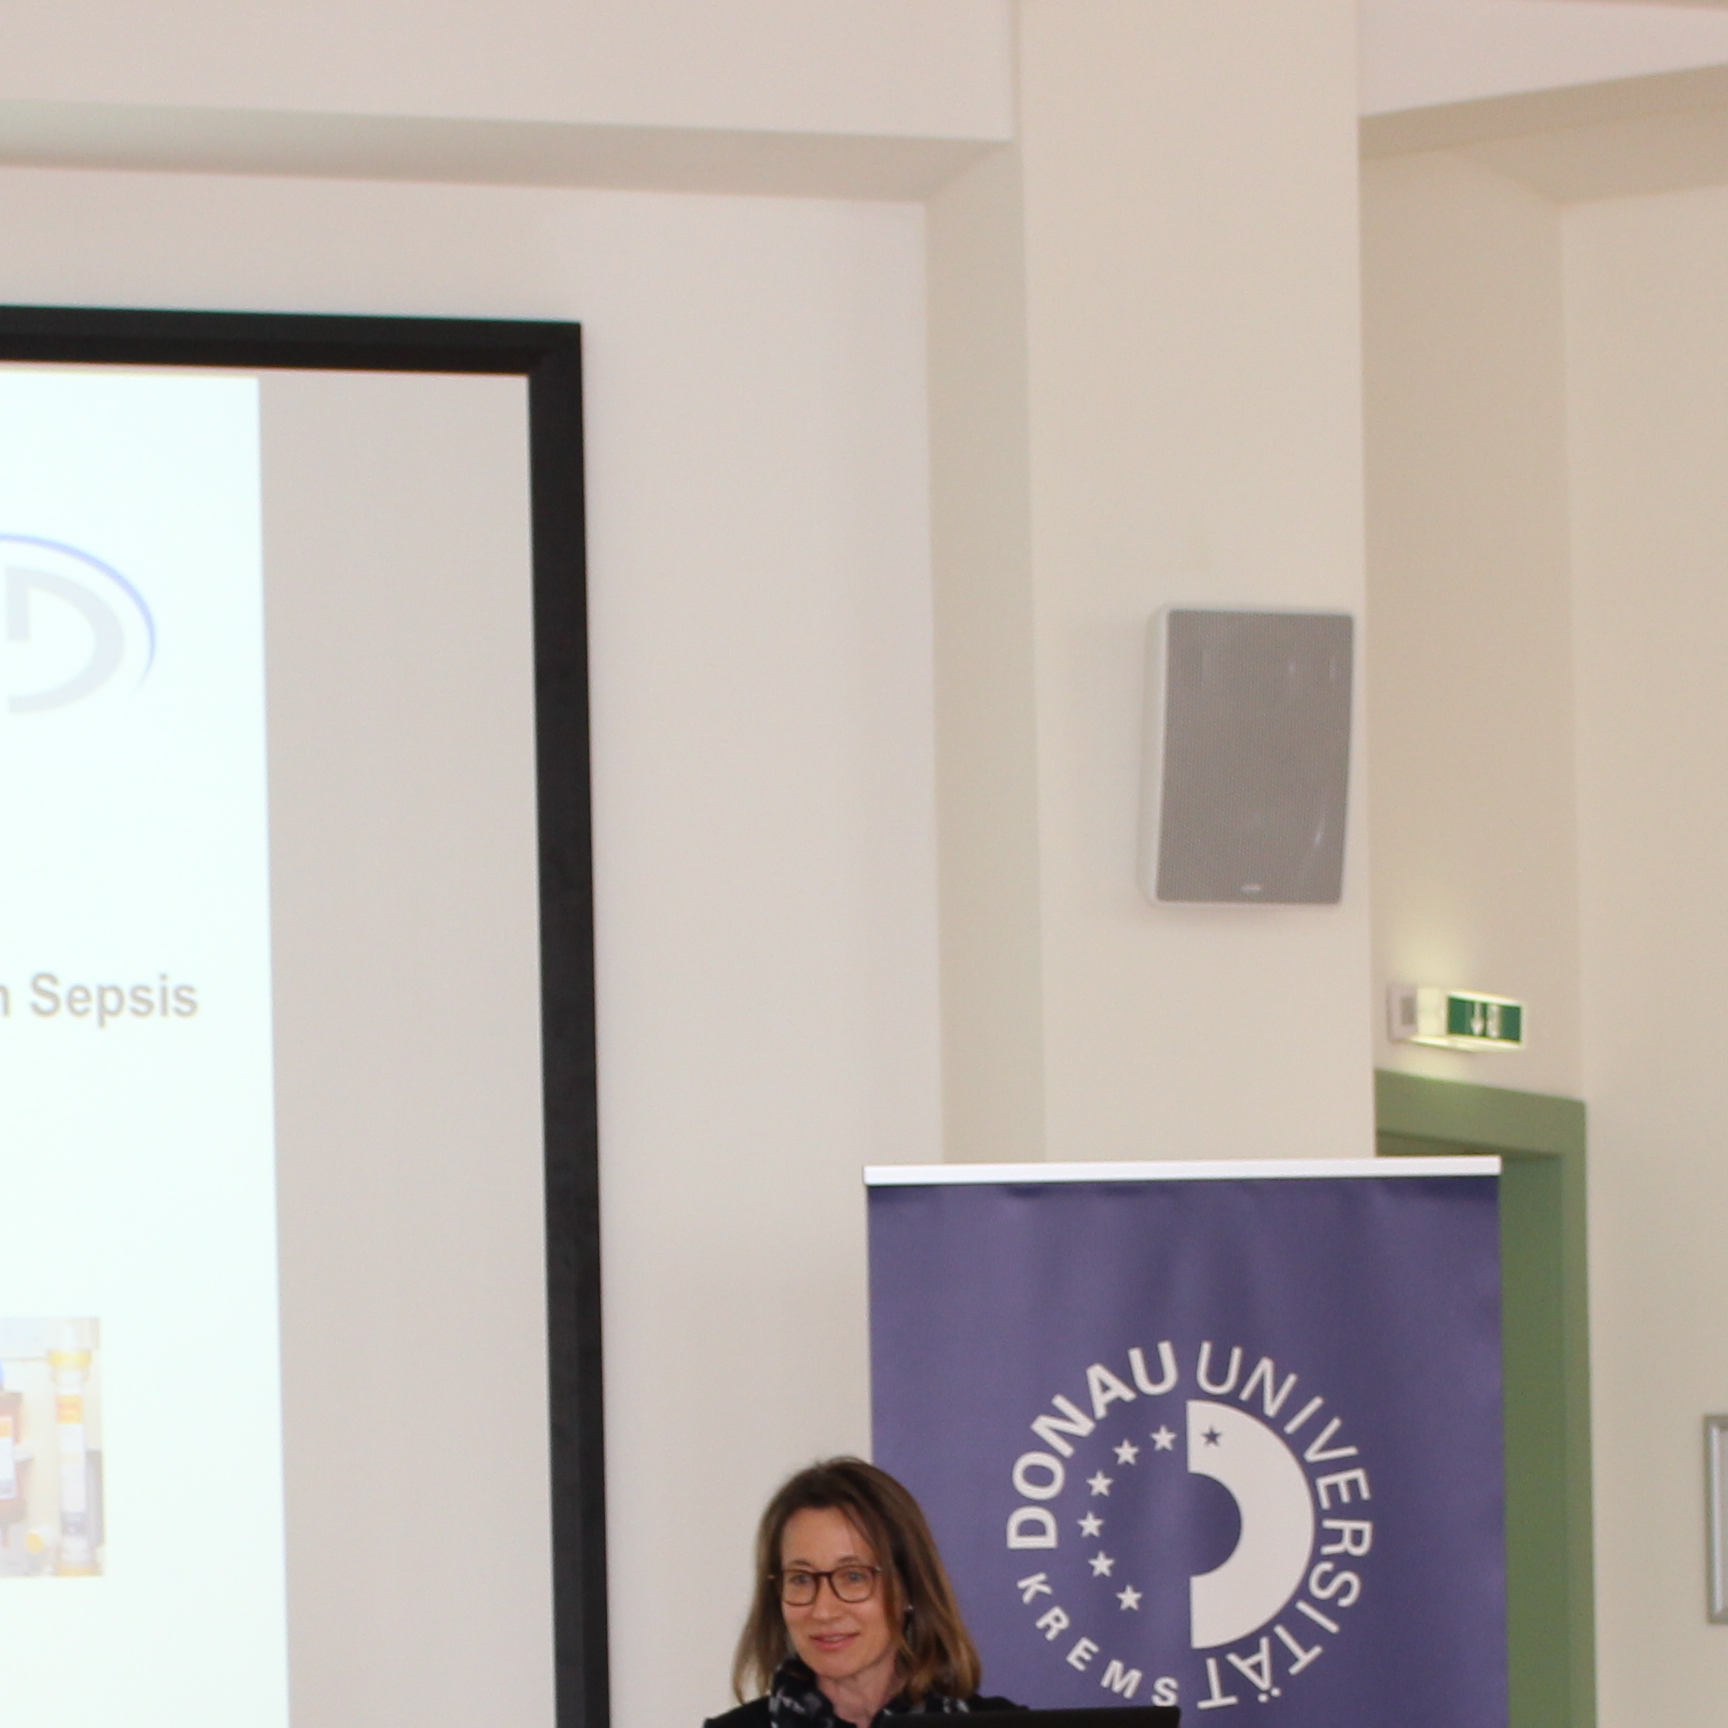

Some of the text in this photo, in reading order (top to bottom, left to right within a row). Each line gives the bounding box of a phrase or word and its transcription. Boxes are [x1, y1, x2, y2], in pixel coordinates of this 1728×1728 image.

[29, 971, 199, 1029] Sepsis
[1006, 1340, 1373, 1709] DONAU UNIVERSITÄT
[1017, 1572, 1179, 1707] KREMS
